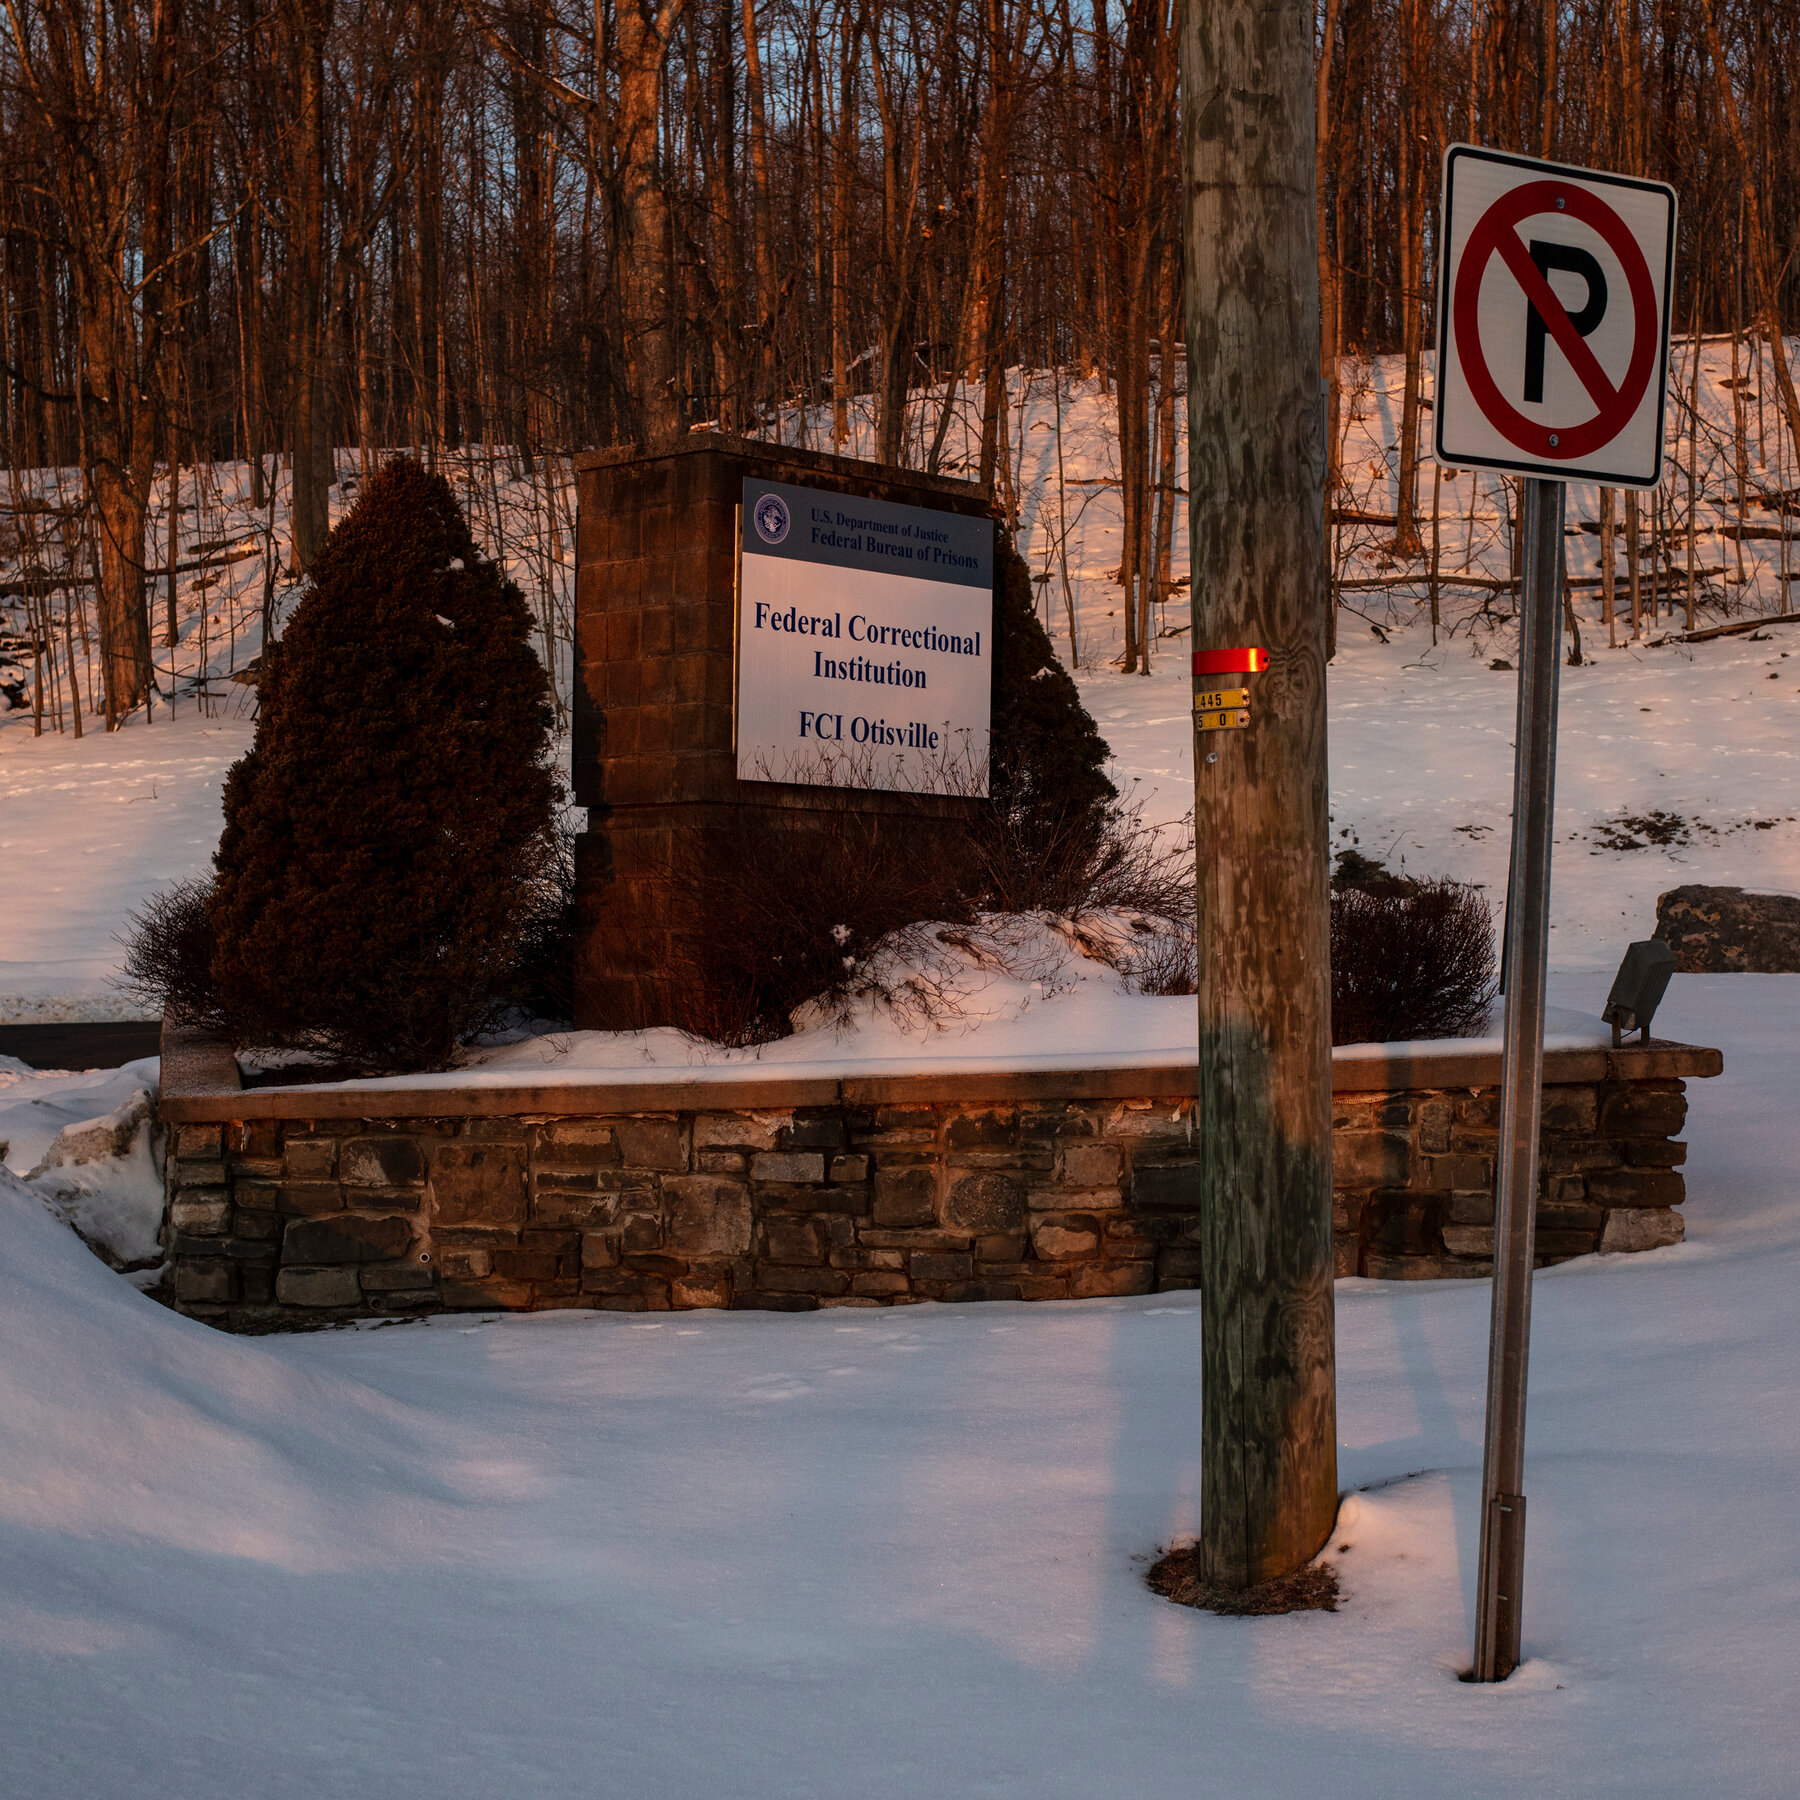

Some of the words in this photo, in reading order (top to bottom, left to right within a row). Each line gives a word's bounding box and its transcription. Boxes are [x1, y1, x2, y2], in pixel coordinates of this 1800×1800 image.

[811, 508, 833, 525] U.S.
[836, 512, 899, 535] Department
[902, 523, 913, 537] of
[914, 527, 948, 544] Justice
[811, 527, 862, 551] Federal
[866, 536, 913, 559] Bureau
[917, 545, 931, 562] of
[933, 549, 979, 569] Prisons
[754, 601, 841, 639] Federal
[848, 615, 981, 657] Correctional
[813, 650, 927, 689] Institution
[798, 711, 843, 741] FCI
[850, 716, 939, 750] Otisville
